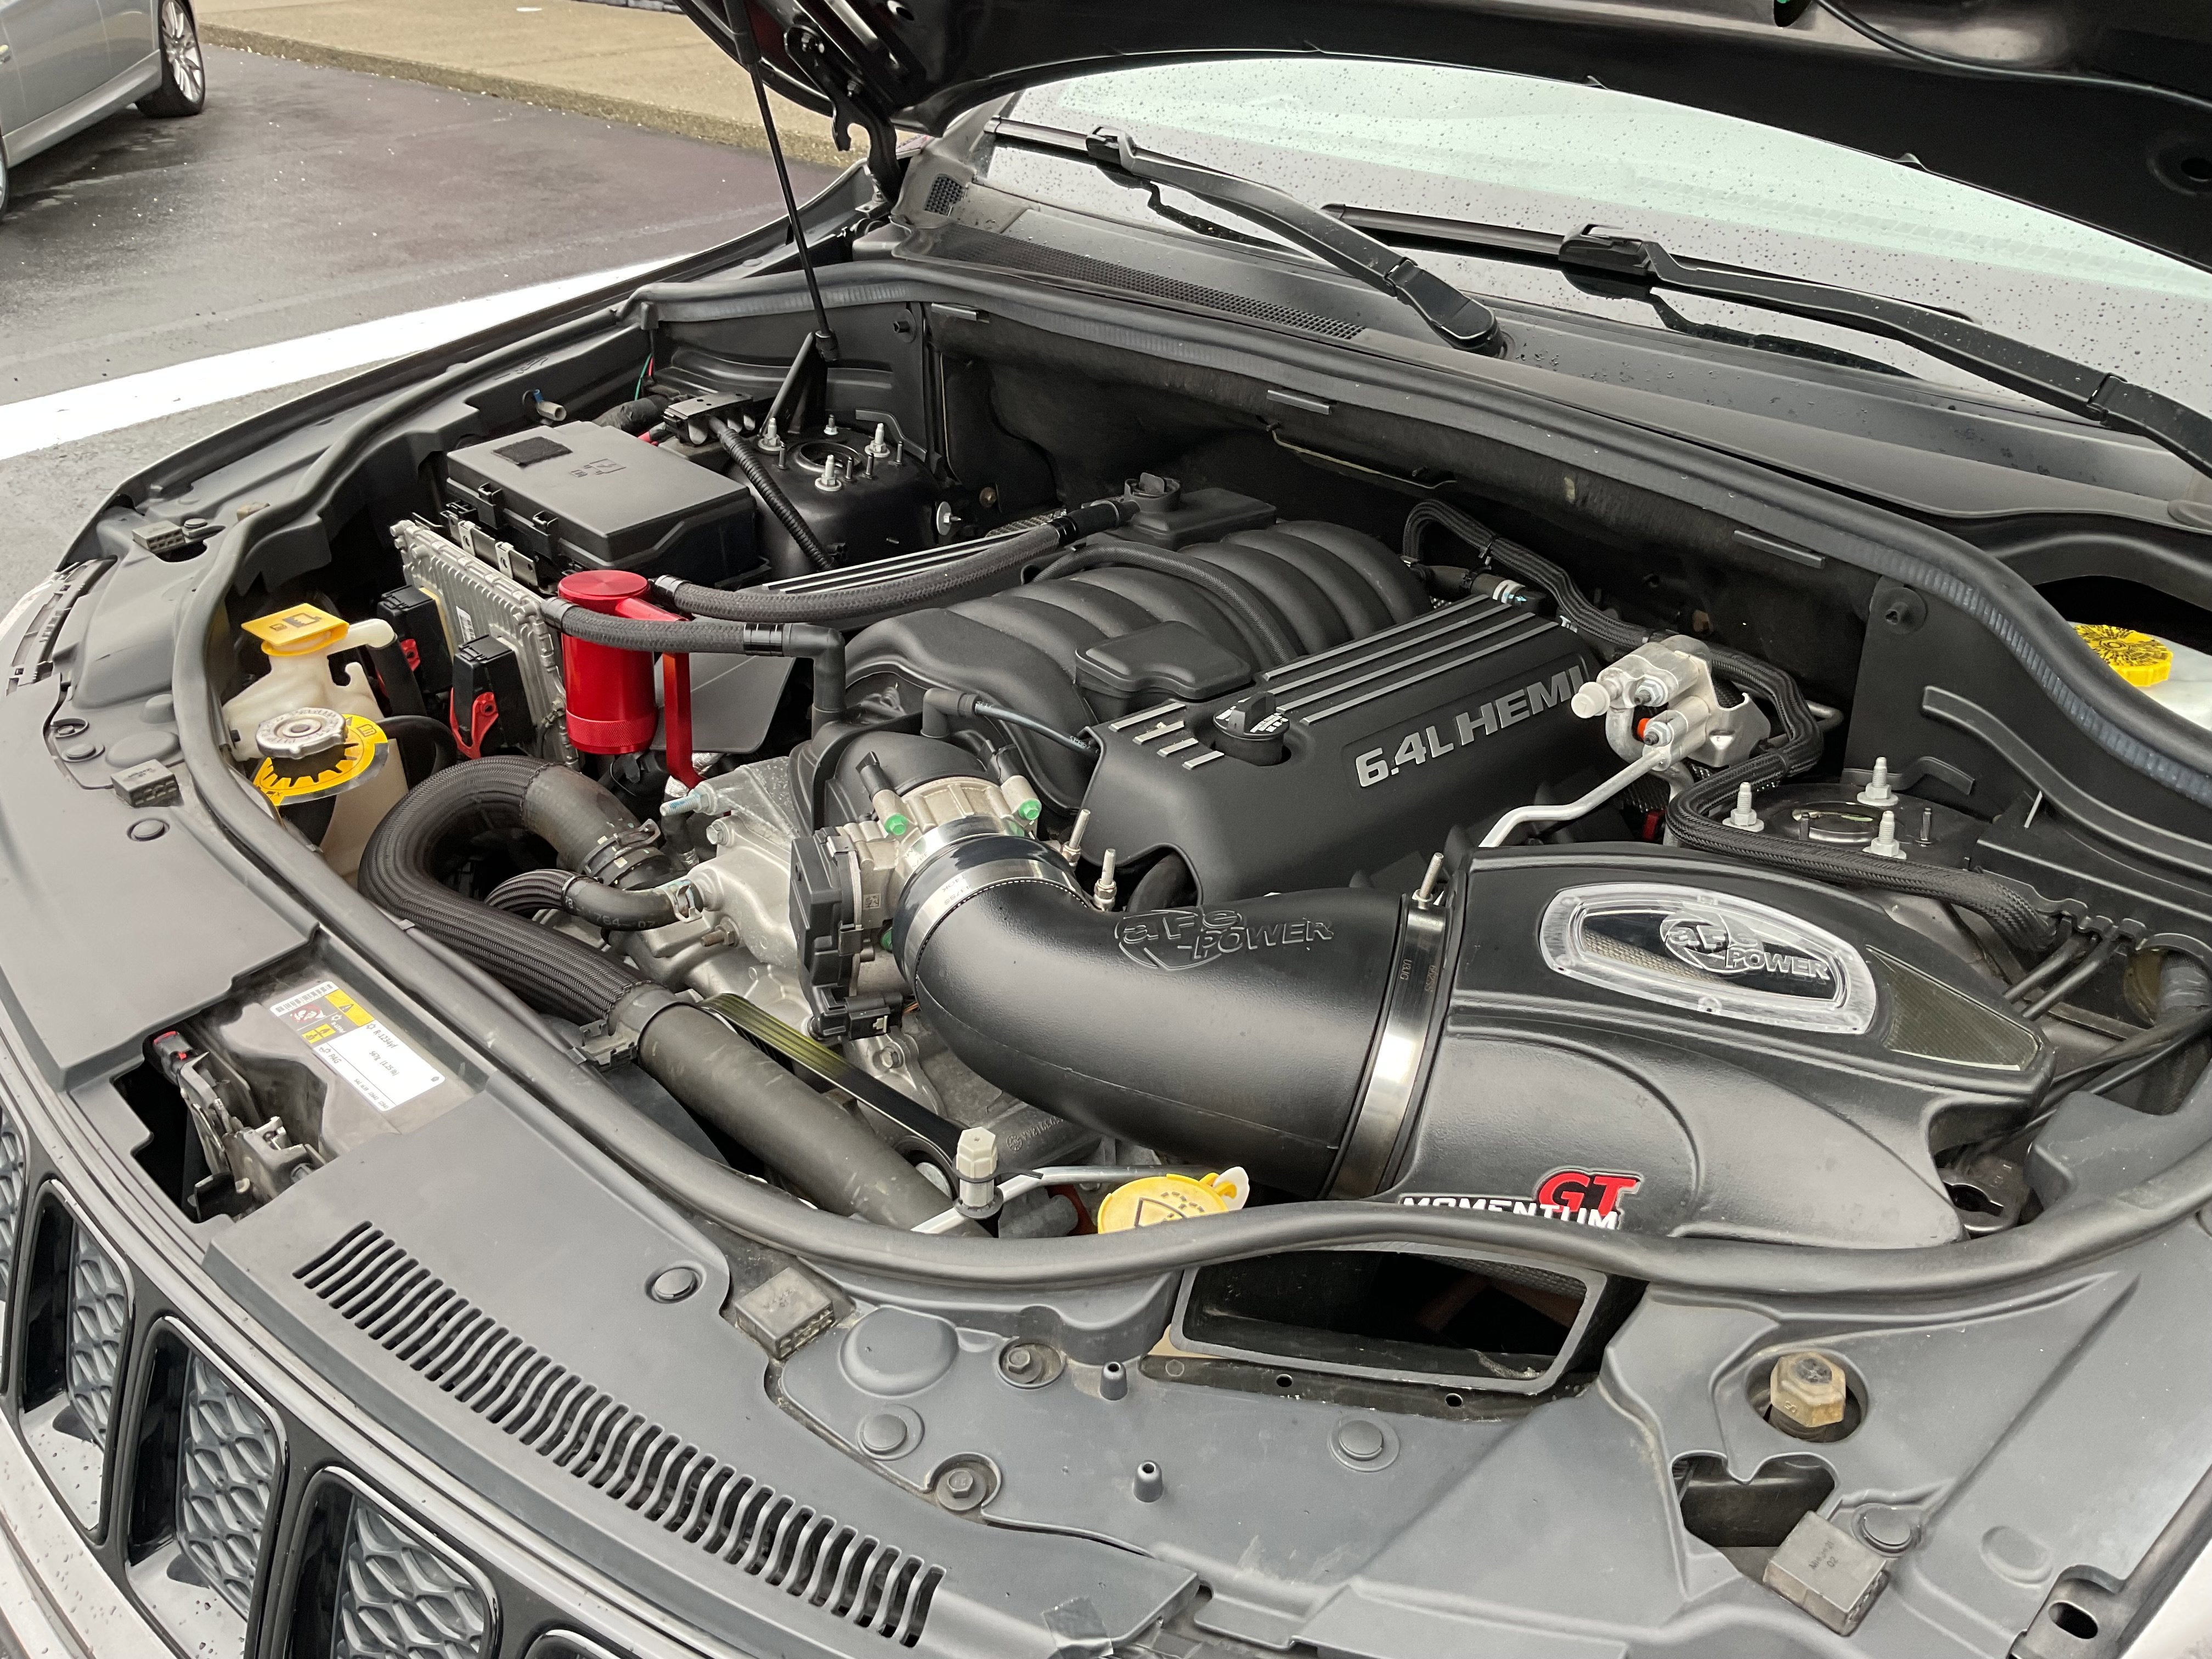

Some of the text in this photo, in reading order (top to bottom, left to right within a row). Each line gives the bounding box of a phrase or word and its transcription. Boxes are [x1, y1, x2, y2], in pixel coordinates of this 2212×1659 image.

[1356, 665, 1584, 788] 6.4L HEMI
[1190, 920, 1335, 960] POWER
[1725, 946, 1831, 981] POWER
[373, 1029, 399, 1048] R-1234yf
[329, 1053, 342, 1064] PAG
[1538, 1172, 1637, 1217] GT
